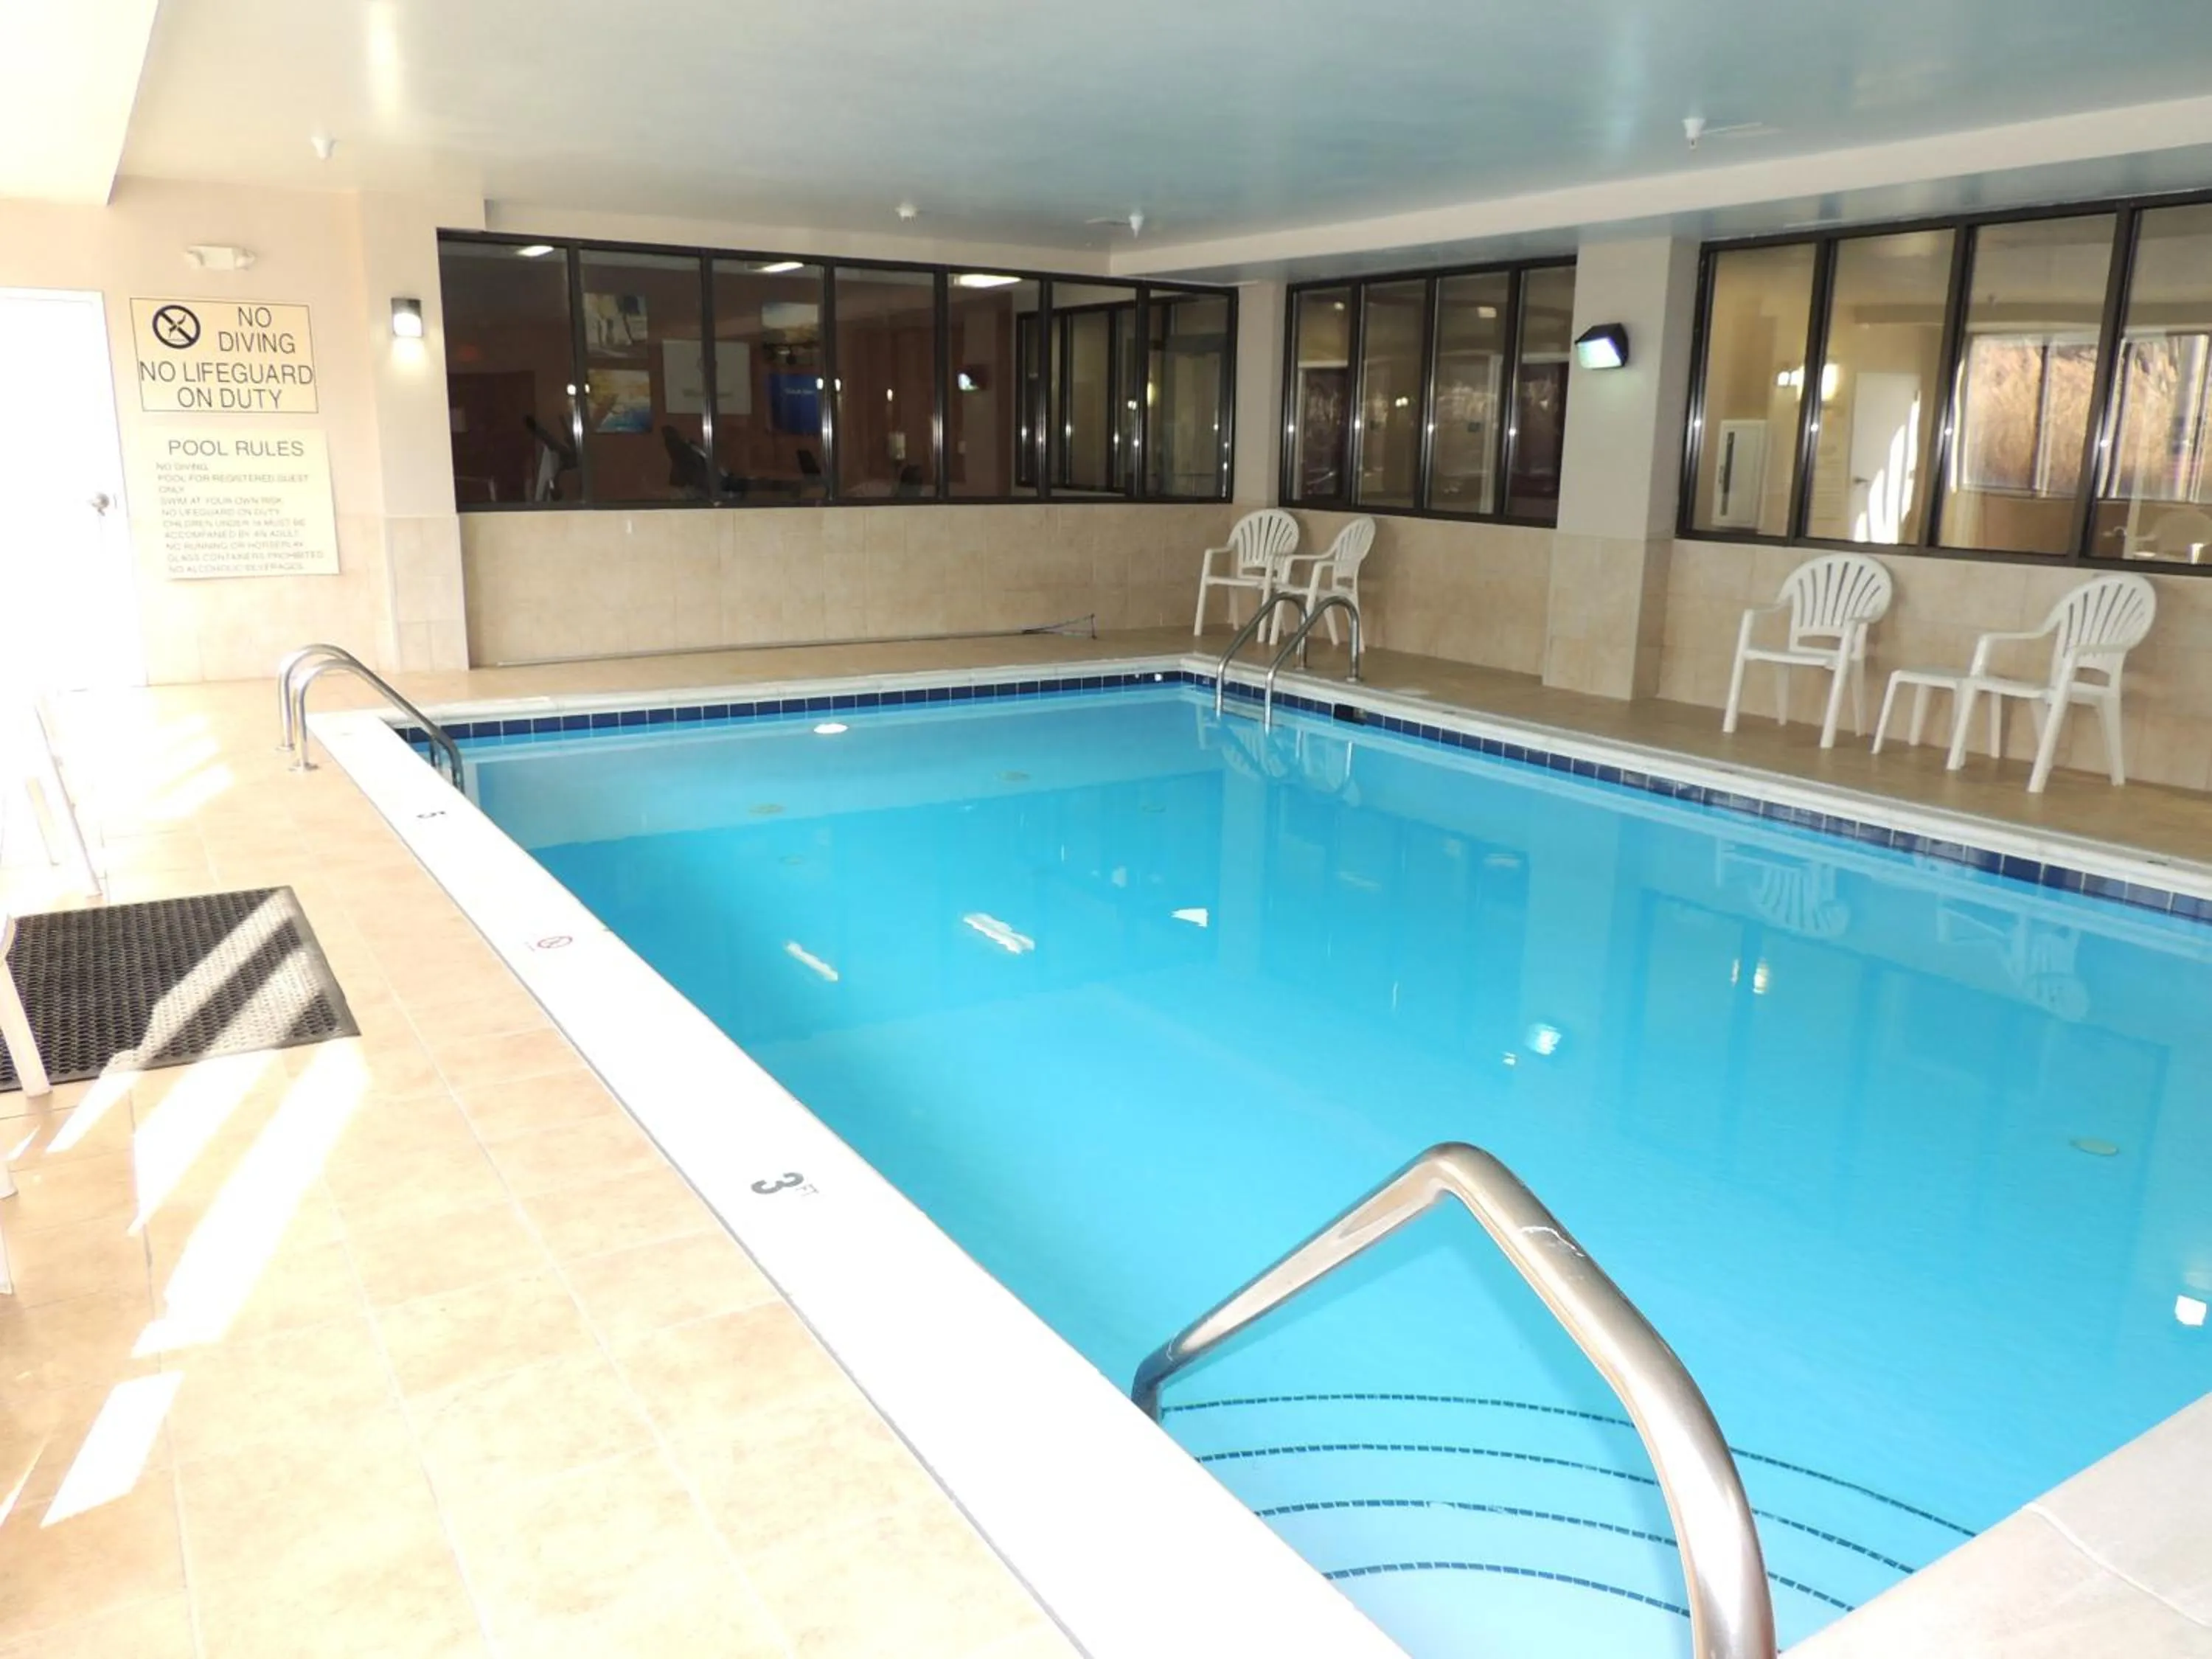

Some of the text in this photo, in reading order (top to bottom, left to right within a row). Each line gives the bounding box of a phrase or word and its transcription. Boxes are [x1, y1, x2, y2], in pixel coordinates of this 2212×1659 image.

[238, 306, 272, 327] NO
[218, 331, 296, 354] DIVING
[139, 361, 313, 385] NO LIFEGUARD
[177, 387, 282, 409] ON DUTY
[168, 439, 305, 456] POOL RULES
[156, 462, 171, 470] NO
[158, 474, 186, 482] POOL
[189, 474, 209, 482] FOR
[212, 474, 274, 482] REGISTERED
[160, 497, 187, 505] SWIM
[161, 509, 177, 517] NO
[215, 519, 249, 527] UNDER
[751, 1172, 804, 1195] 3
